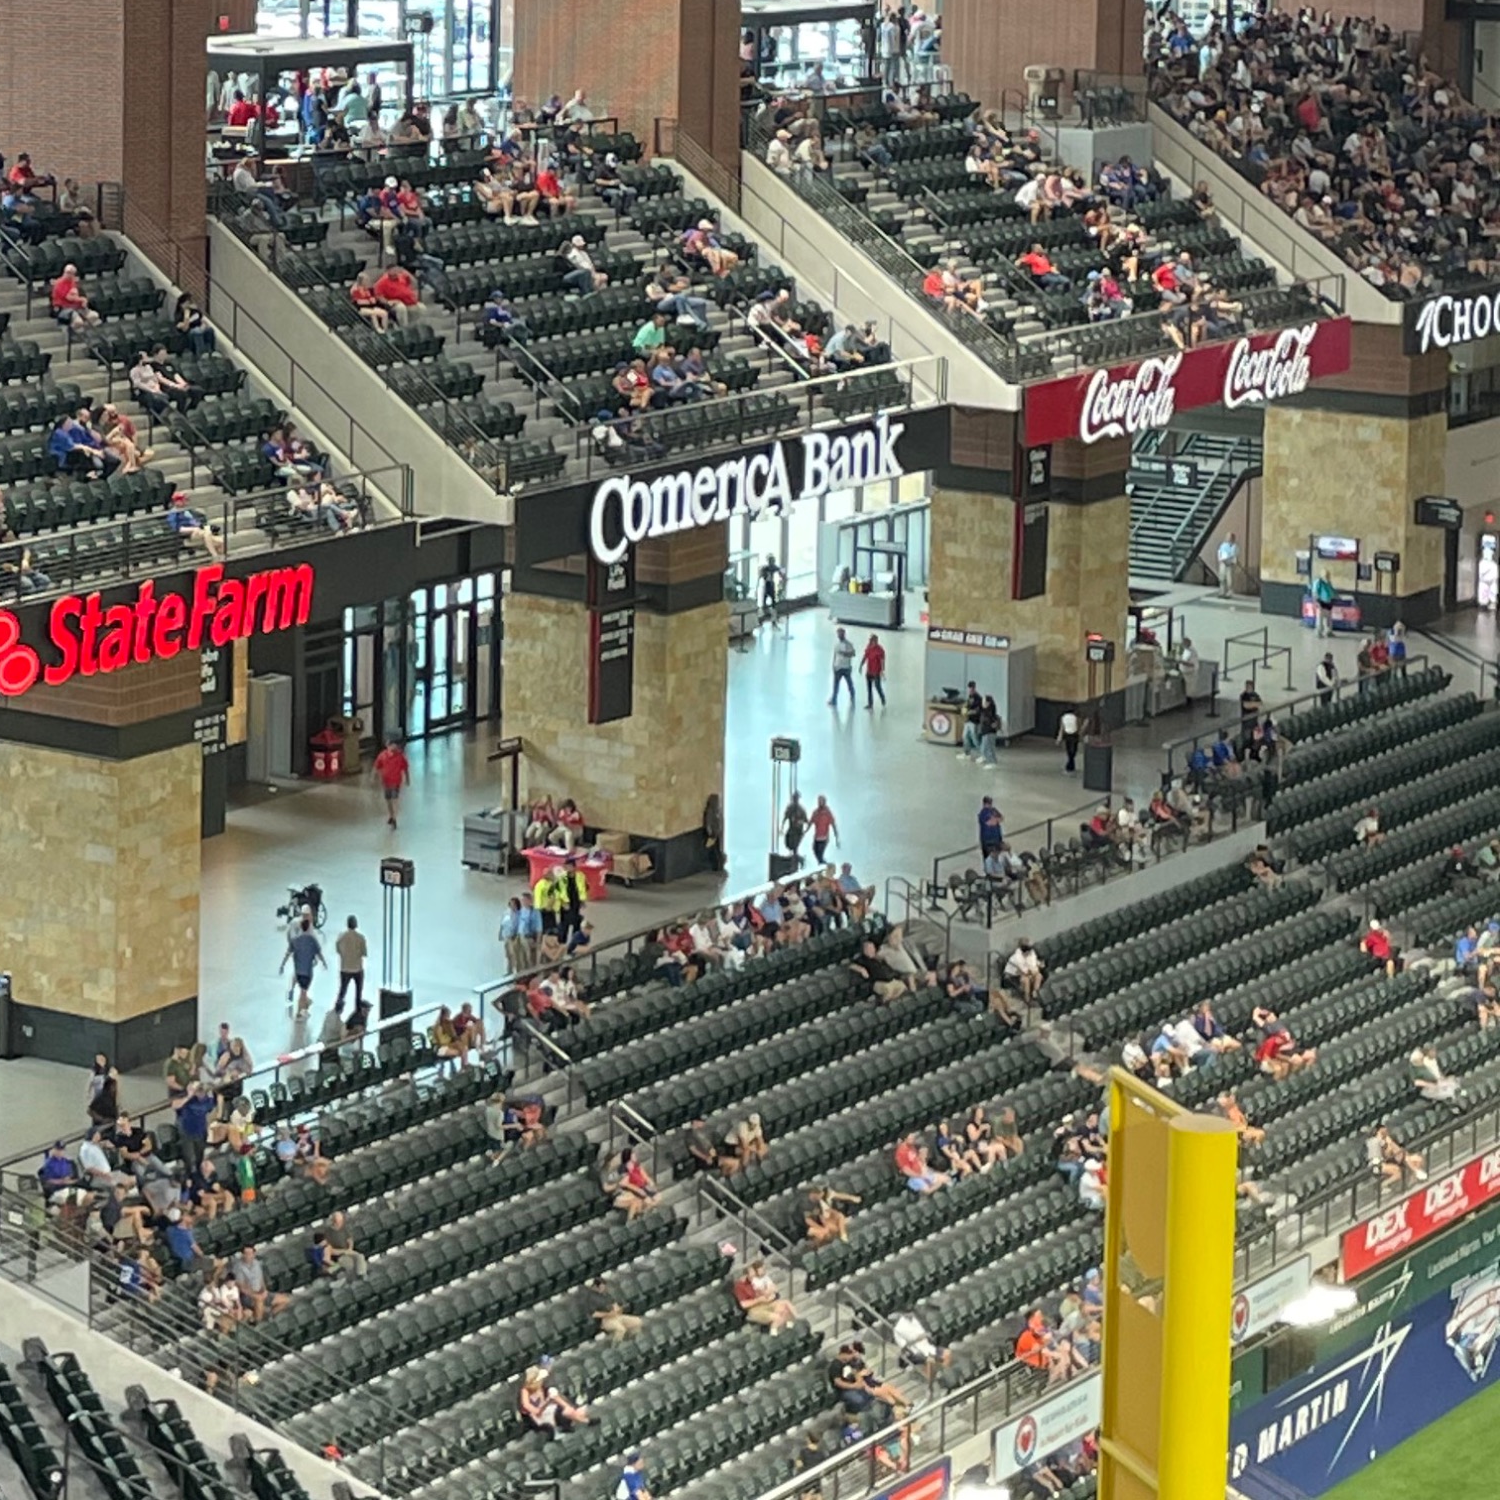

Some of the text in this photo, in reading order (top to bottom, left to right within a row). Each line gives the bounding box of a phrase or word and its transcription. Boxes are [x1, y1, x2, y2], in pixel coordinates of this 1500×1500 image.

[800, 414, 905, 500] Bank
[1364, 1199, 1410, 1252] DEX
[1423, 1168, 1466, 1218] DEX
[1257, 1378, 1349, 1463] MARTIN
